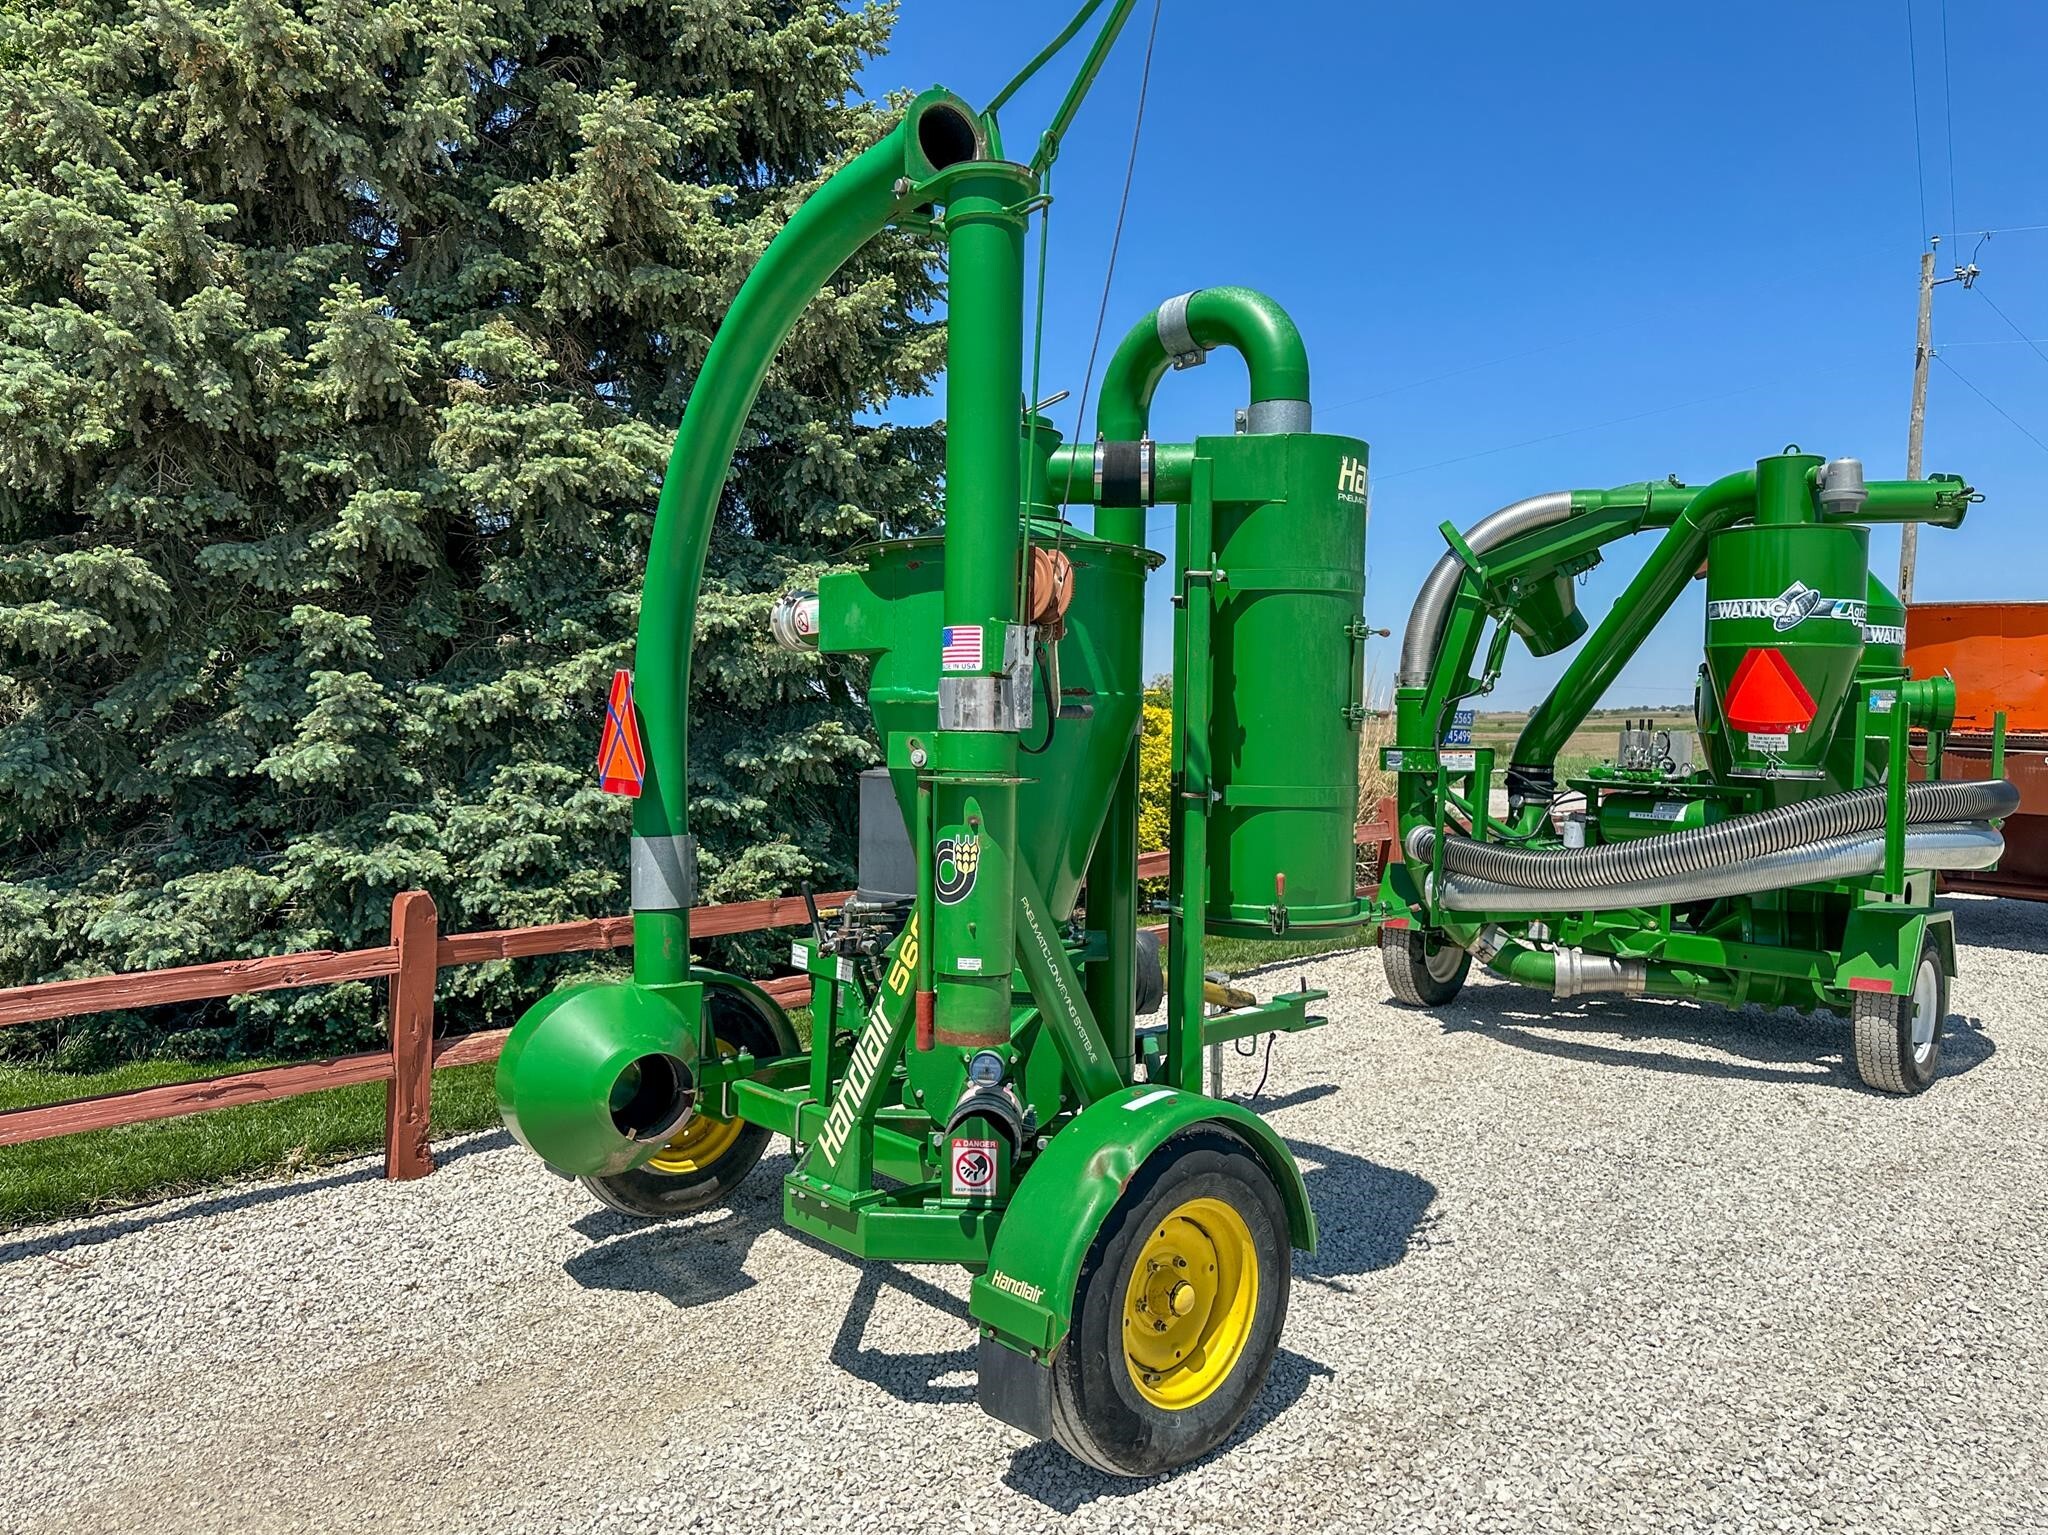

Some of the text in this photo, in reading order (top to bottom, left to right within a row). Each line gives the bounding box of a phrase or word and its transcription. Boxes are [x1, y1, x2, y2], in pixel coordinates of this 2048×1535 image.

[1338, 455, 1367, 496] Ha
[1718, 600, 1802, 619] WALINGA
[1020, 896, 1052, 959] PNEUMATIC
[963, 1140, 996, 1148] DANGER
[991, 1269, 1045, 1304] Handlair
